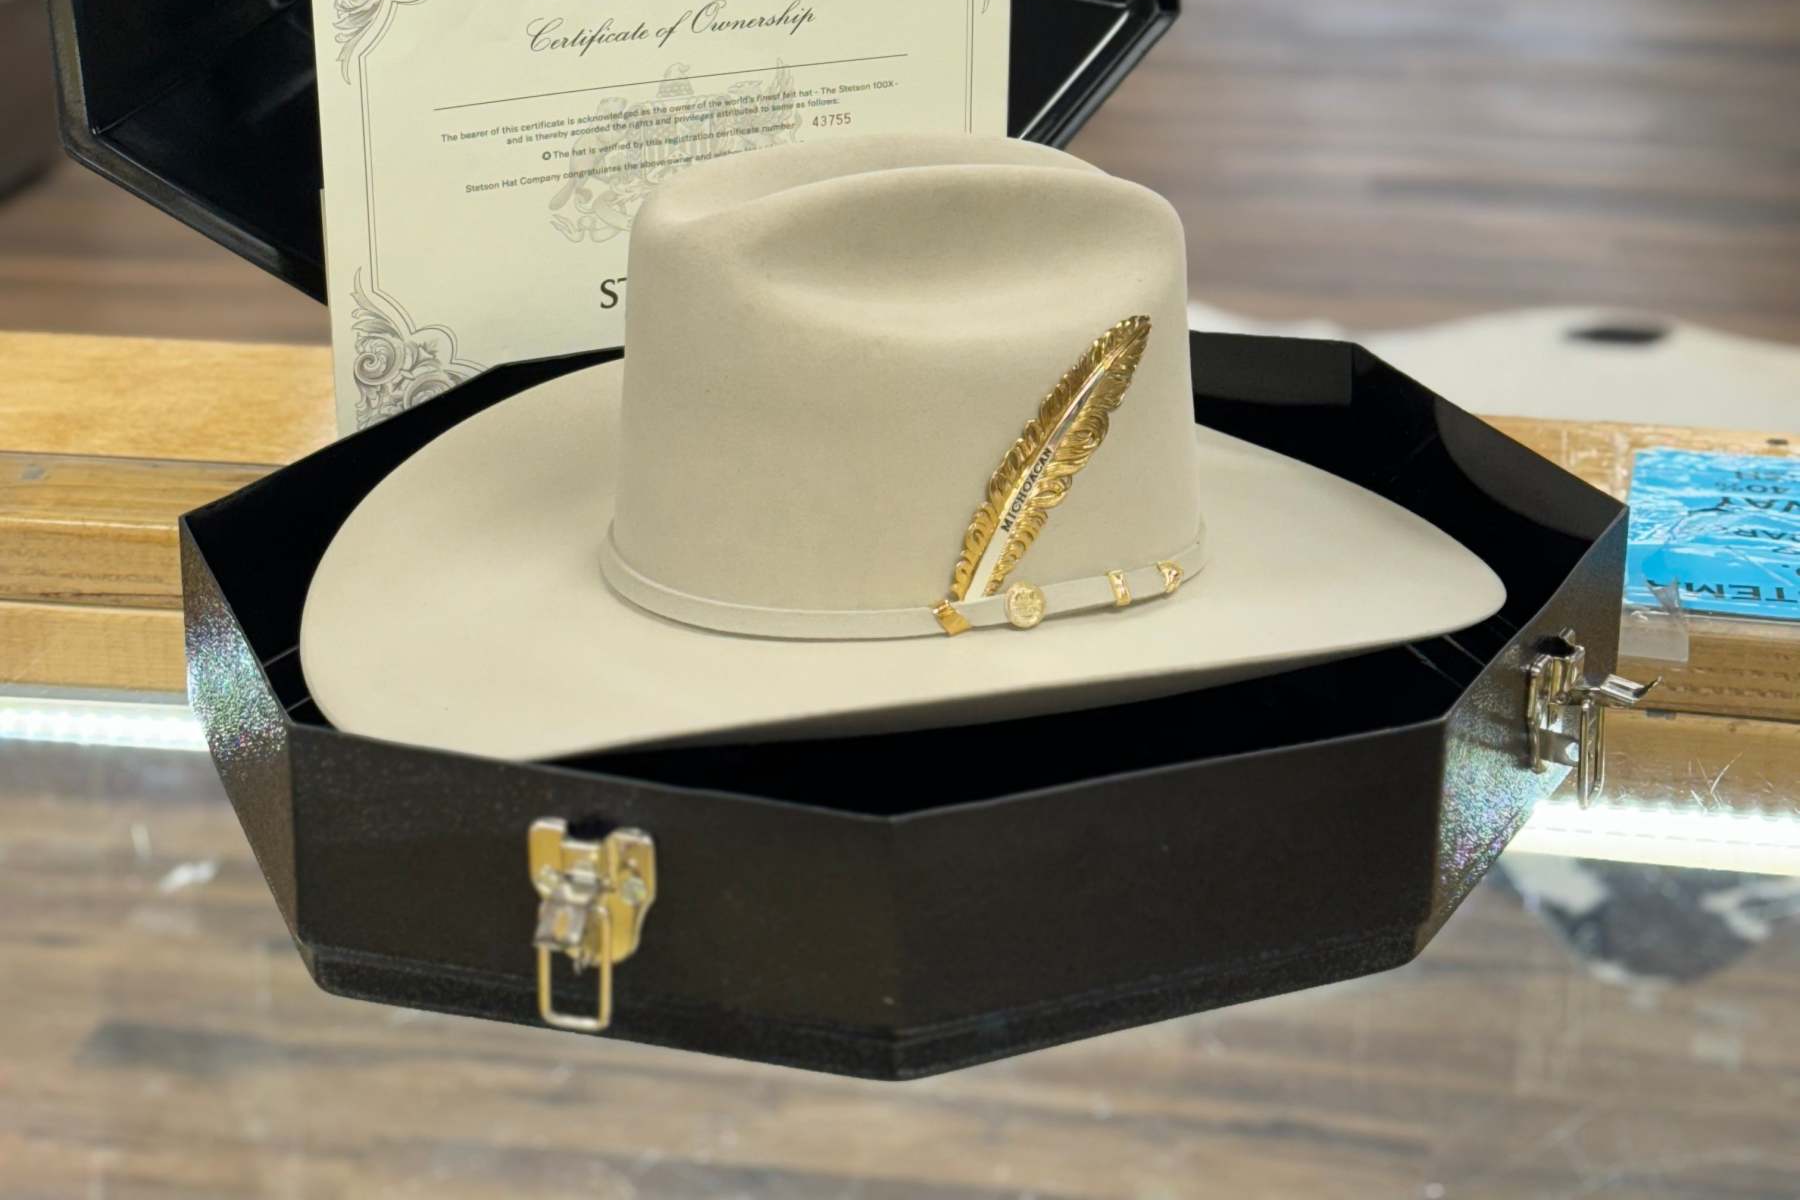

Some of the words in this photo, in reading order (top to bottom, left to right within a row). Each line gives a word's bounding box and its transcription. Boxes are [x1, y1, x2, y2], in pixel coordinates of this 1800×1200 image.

[526, 17, 650, 57] Certificate
[655, 10, 693, 48] of
[691, 0, 816, 35] Ownership
[441, 134, 458, 142] The
[460, 130, 488, 139] bearer
[491, 126, 500, 135] of
[502, 126, 519, 134] this
[520, 120, 565, 132] certificate
[567, 117, 575, 125] is
[577, 109, 639, 125] acknowledged
[653, 105, 667, 113] the
[669, 103, 696, 112] owner
[697, 100, 706, 108] of
[708, 99, 721, 107] the
[724, 95, 755, 106] world's
[799, 89, 812, 97] hat
[820, 87, 837, 95] The
[839, 82, 871, 93] Stetson
[506, 137, 523, 145] and
[525, 134, 533, 142] is
[535, 130, 568, 141] thereby
[571, 125, 611, 136] accorded
[612, 122, 627, 130] the
[629, 120, 653, 130] rights
[655, 116, 671, 125] and
[674, 113, 714, 124] privileges
[553, 150, 570, 159] The
[572, 147, 586, 156] hat
[589, 146, 596, 154] is
[599, 140, 632, 152] verified
[633, 141, 643, 150] by
[664, 132, 714, 145] registration
[716, 126, 760, 138] certificate
[812, 112, 852, 128] 43755
[465, 181, 500, 193] Stetson
[502, 178, 517, 188] Hat
[520, 173, 561, 185] Company
[563, 164, 621, 179] congratulates
[624, 162, 639, 170] the
[696, 152, 712, 161] and
[1001, 447, 1052, 532] MICHOACAN
[1647, 579, 1800, 603] TEM
